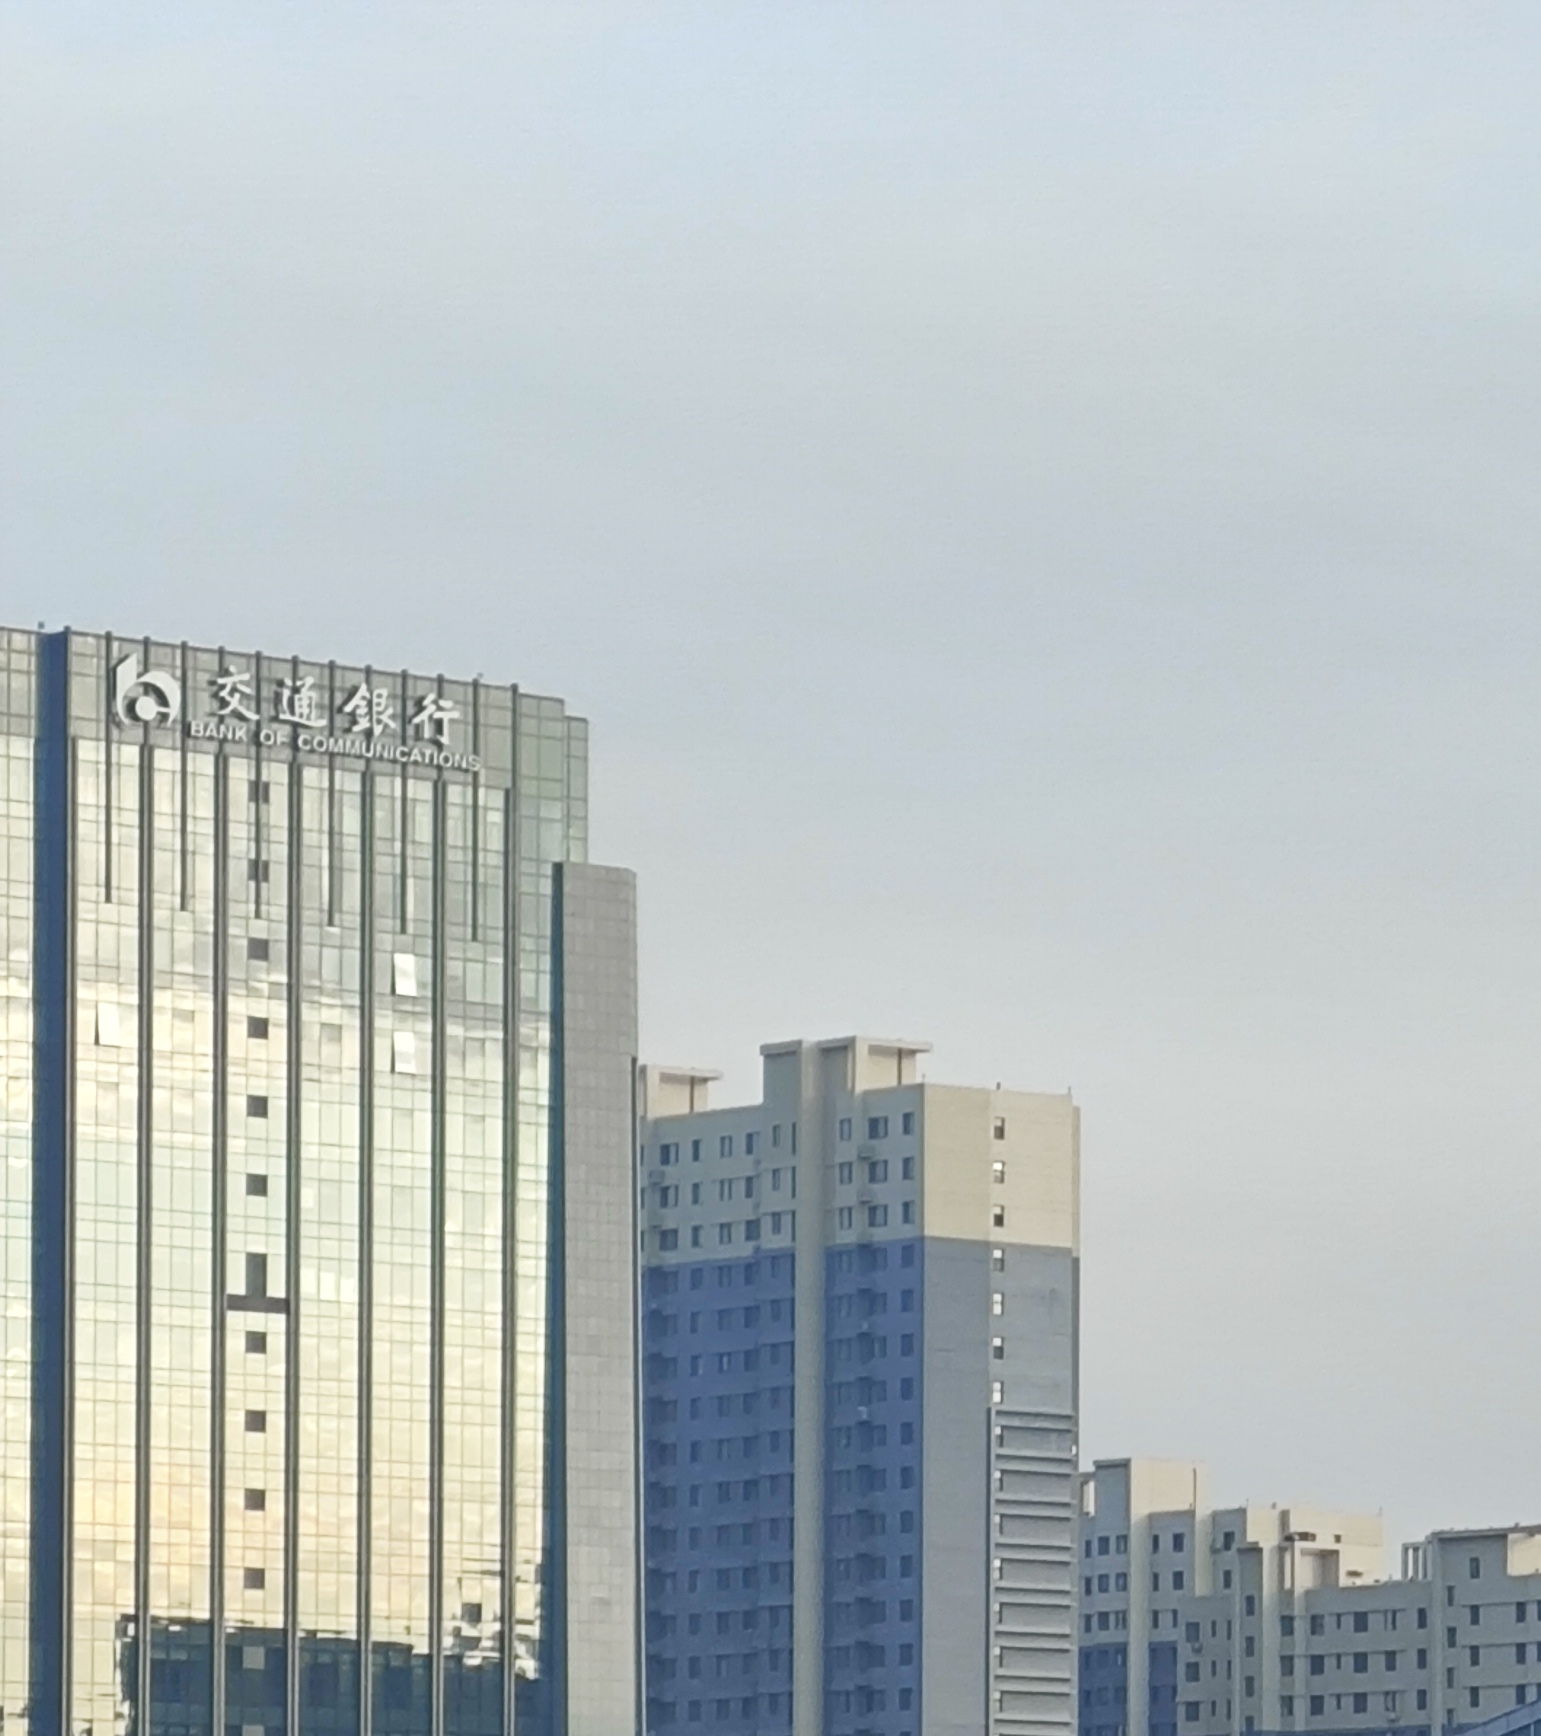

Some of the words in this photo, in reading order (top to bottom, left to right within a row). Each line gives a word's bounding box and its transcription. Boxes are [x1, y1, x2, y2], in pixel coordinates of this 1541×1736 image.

[215, 665, 461, 745] 交通銀行
[188, 719, 248, 743] BANK
[259, 728, 289, 748] OF
[297, 735, 482, 772] COMMUNICATIONS
